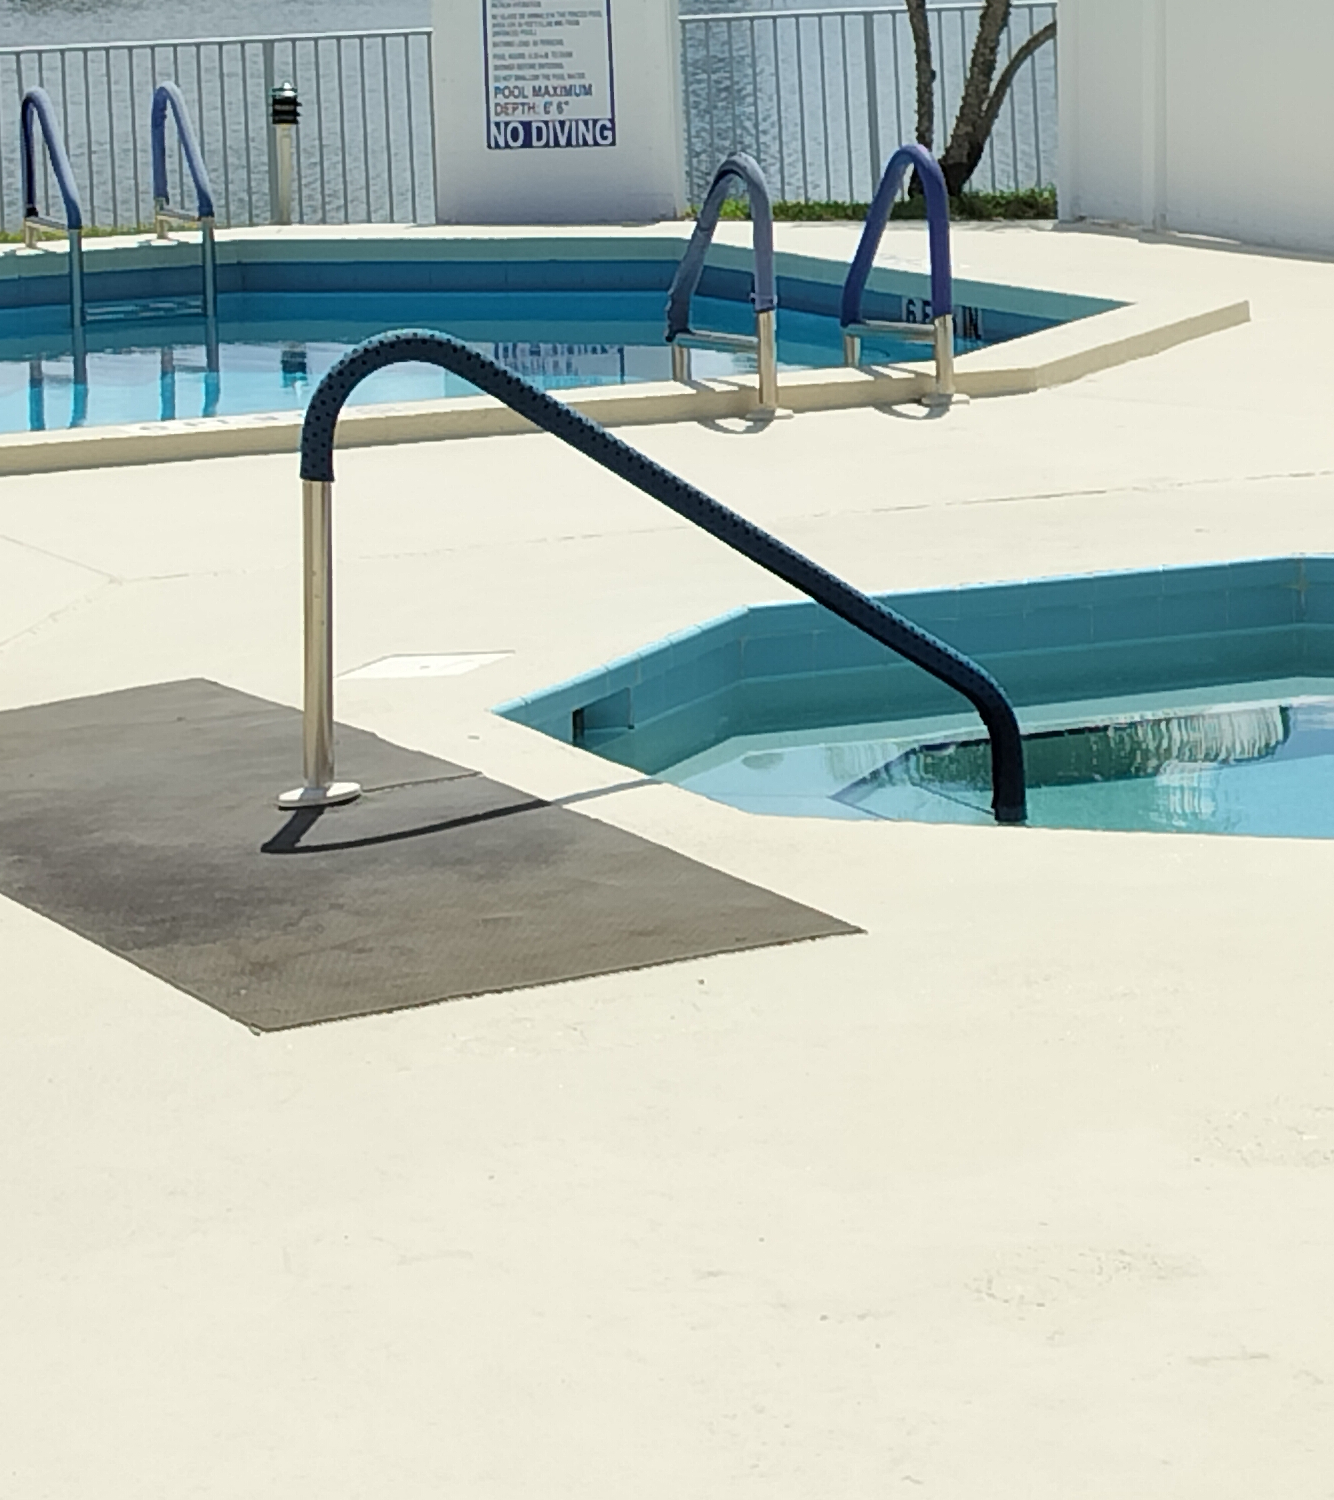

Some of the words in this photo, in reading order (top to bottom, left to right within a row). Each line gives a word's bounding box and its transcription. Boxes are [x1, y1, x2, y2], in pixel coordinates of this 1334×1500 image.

[494, 86, 528, 99] POOL
[532, 84, 593, 98] MAXIMUM
[491, 122, 524, 148] NO
[532, 120, 612, 147] DIVING
[906, 299, 916, 323] 6
